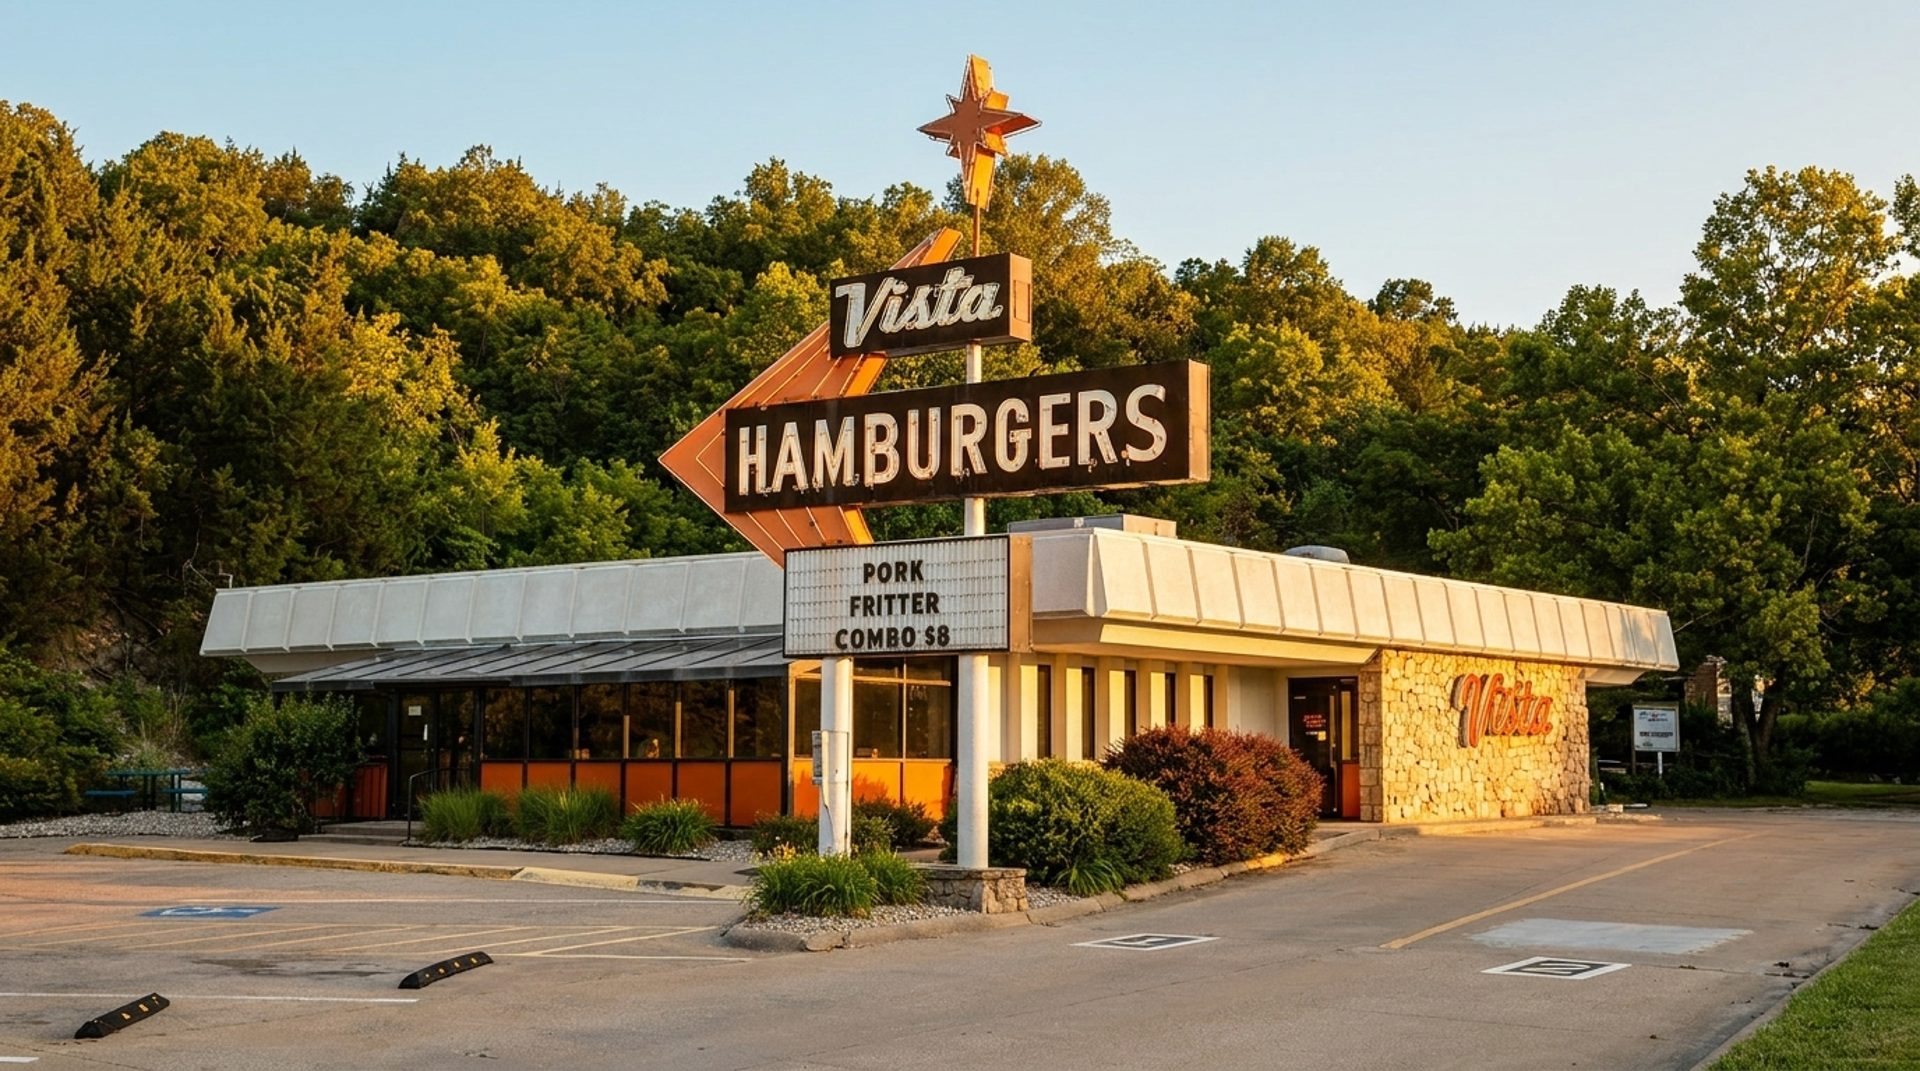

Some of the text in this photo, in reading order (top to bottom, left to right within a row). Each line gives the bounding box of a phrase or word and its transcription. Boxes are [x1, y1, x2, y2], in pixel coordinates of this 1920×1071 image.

[835, 266, 1003, 348] Vista
[738, 384, 1168, 496] HAMBURGERS
[863, 560, 924, 584] PORK
[850, 592, 940, 617] FRITTER
[835, 626, 916, 649] COMBO
[1450, 673, 1554, 748] Vista
